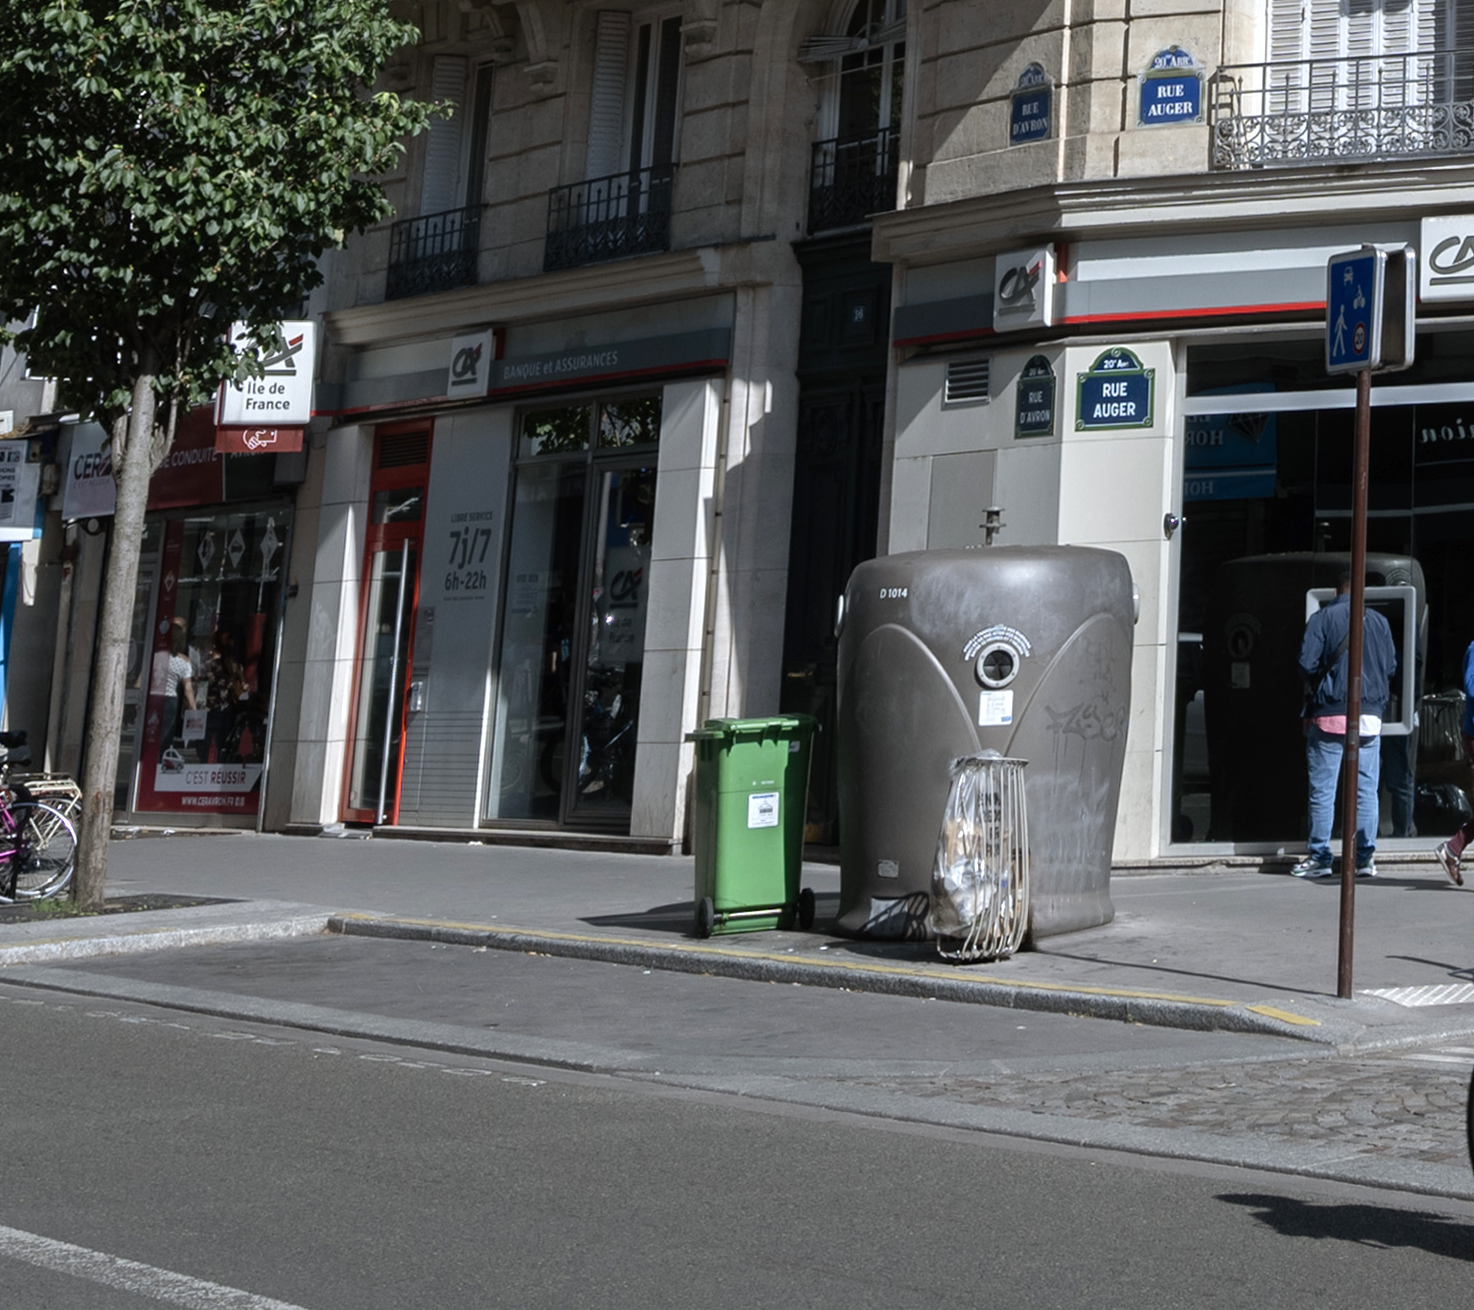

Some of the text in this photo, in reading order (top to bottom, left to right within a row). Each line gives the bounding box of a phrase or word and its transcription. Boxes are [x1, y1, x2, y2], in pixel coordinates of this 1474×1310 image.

[1157, 84, 1184, 99] RUE
[1022, 102, 1039, 116] RUE
[1148, 102, 1193, 117] AUGER
[1012, 118, 1048, 135] D'AVRON
[504, 351, 619, 380] BANQUE et ASSURANCES
[269, 383, 285, 395] de
[1102, 382, 1128, 398] RUE
[245, 398, 291, 410] France
[1028, 391, 1043, 403] RUE
[1020, 409, 1051, 424] D'AVRON
[1093, 402, 1136, 418] AUGER
[171, 447, 218, 464] CONDUITE
[451, 511, 493, 523] LIBRE SERVICE
[449, 526, 492, 570] 7j/7
[887, 588, 908, 599] 1014
[185, 771, 208, 785] C'EST
